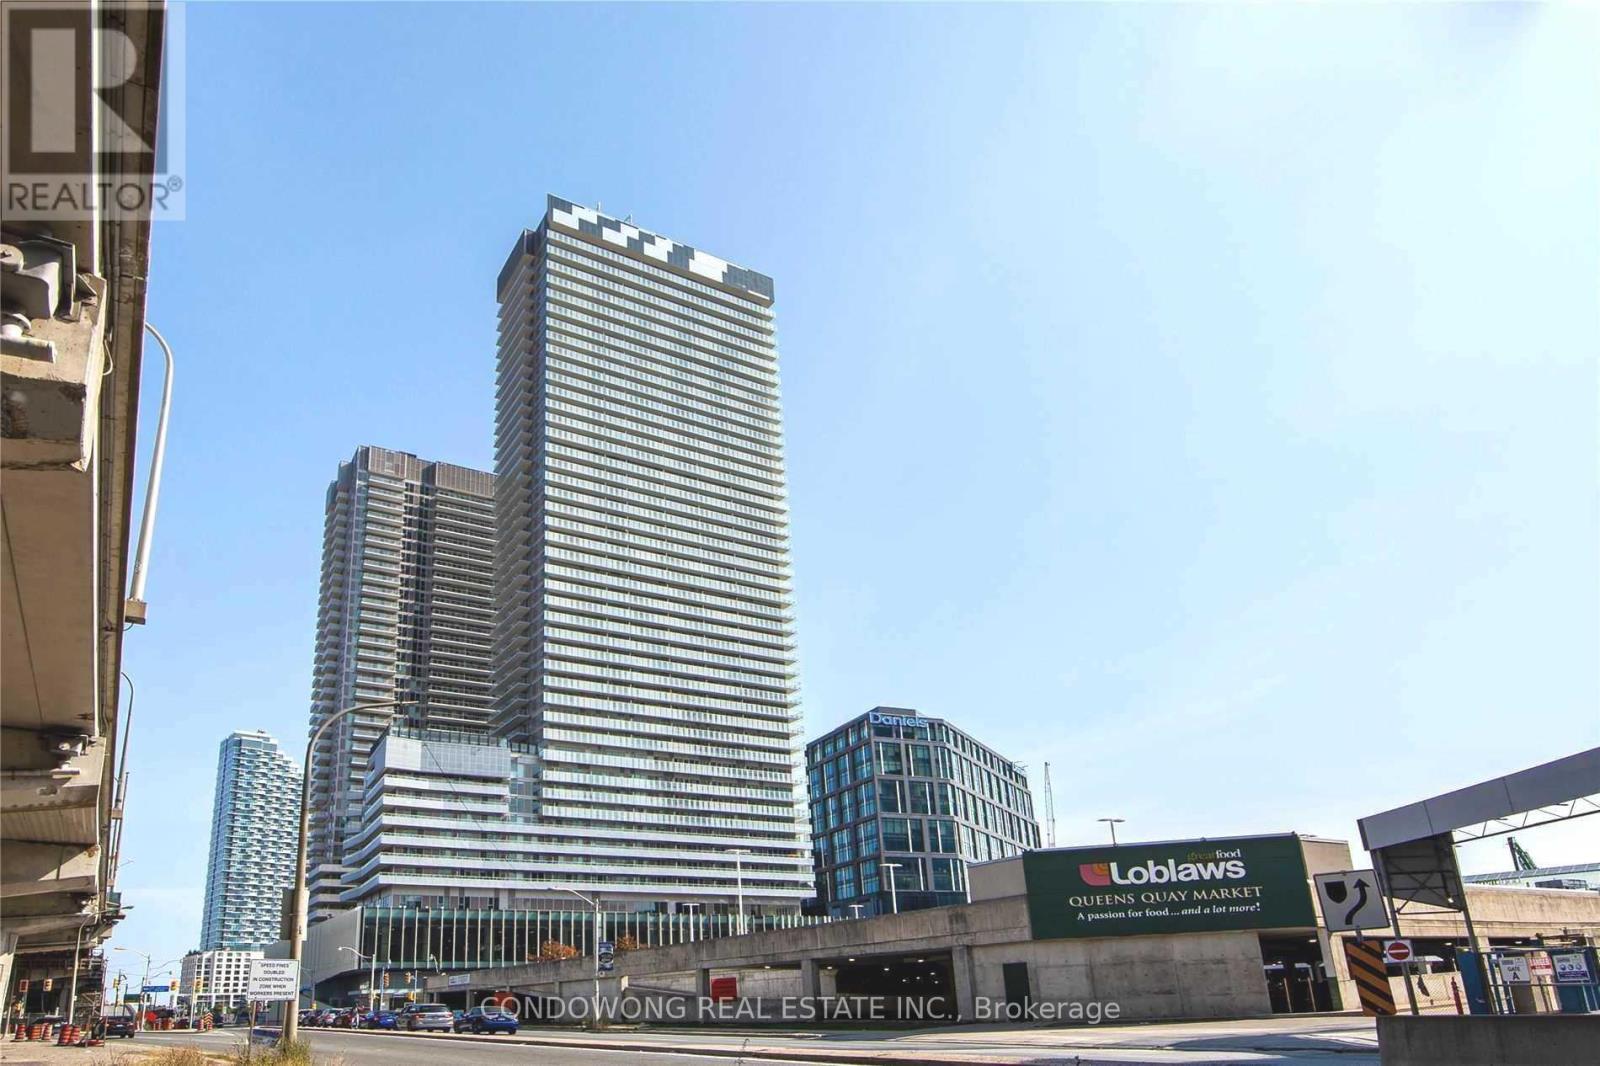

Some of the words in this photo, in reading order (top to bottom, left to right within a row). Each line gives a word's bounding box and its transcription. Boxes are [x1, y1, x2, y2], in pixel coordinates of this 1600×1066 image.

[869, 711, 928, 728] Daniels
[1216, 848, 1241, 859] food
[1109, 859, 1246, 885] Loblaws
[1069, 893, 1135, 908] QUEENS
[1141, 890, 1188, 904] QUAY
[1193, 886, 1263, 901] MARKET
[1077, 912, 1085, 921] A
[1088, 910, 1126, 922] passion
[1128, 908, 1143, 918] for
[1203, 906, 1210, 914] a
[1212, 904, 1226, 914] lot
[1229, 901, 1261, 914] more!
[1512, 972, 1520, 980] A
